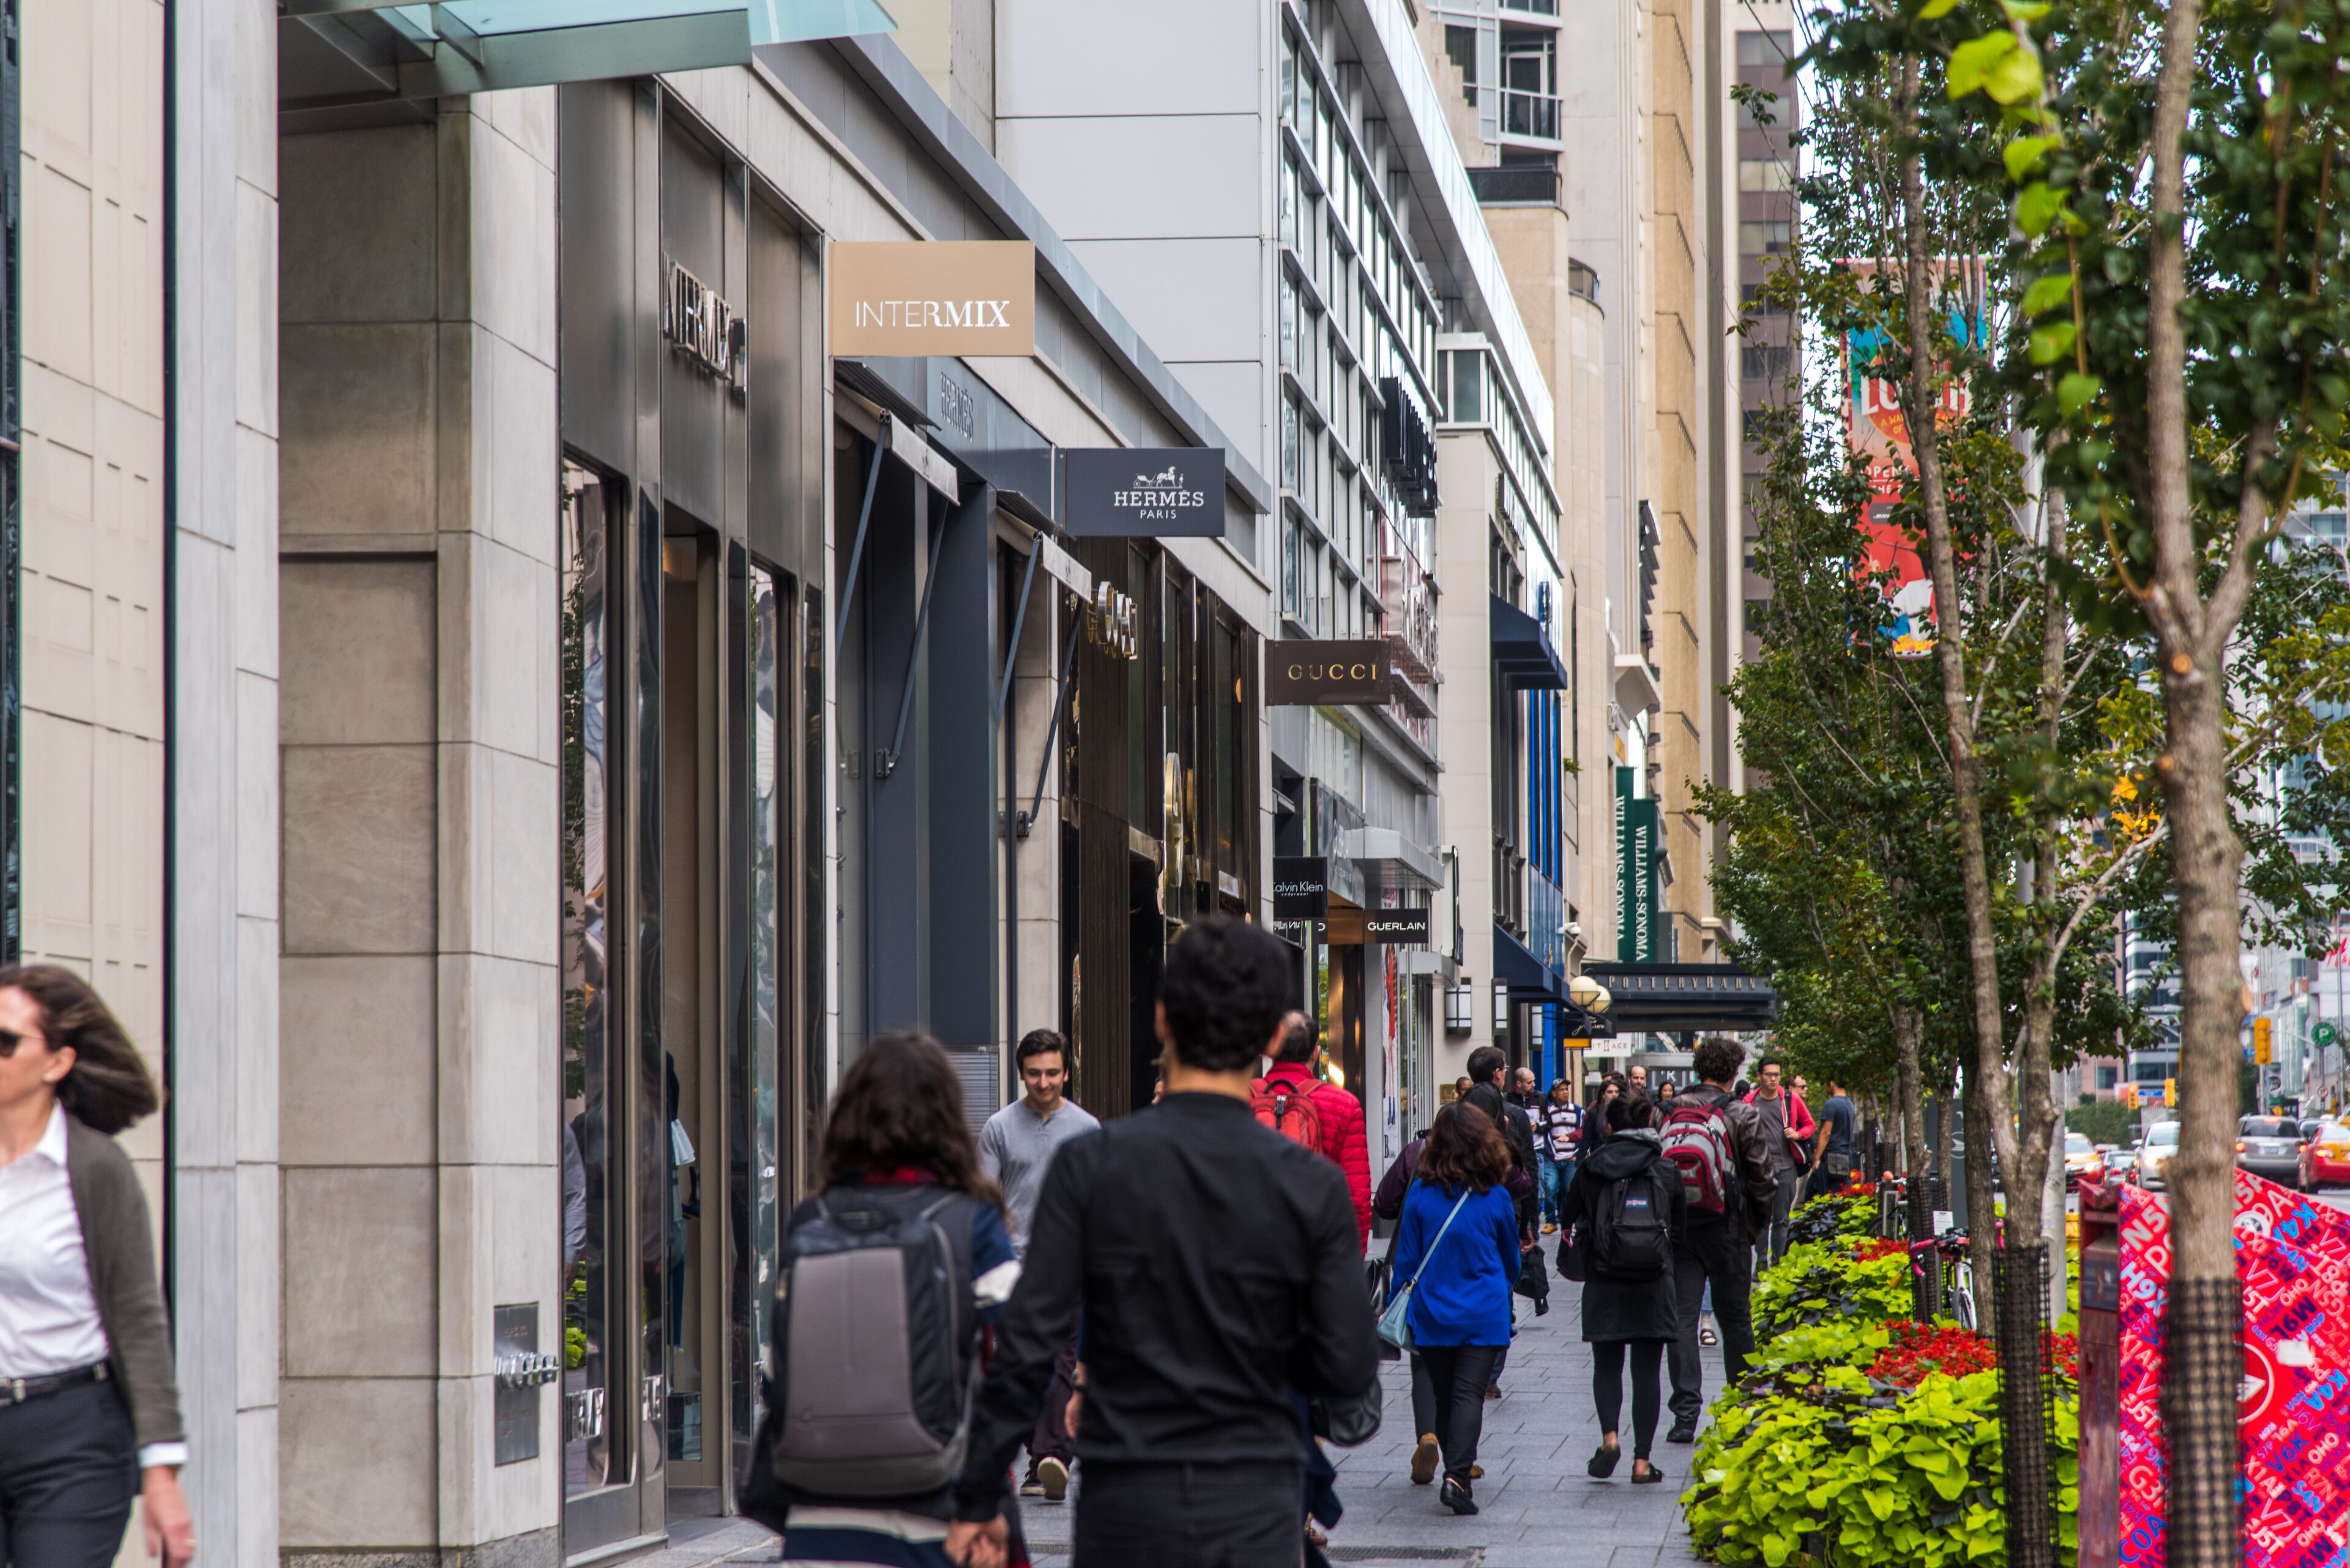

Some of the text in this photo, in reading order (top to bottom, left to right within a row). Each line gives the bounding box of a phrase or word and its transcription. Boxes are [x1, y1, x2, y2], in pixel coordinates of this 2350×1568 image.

[856, 300, 1010, 327] INTERMIX
[1140, 509, 1176, 520] PARIS
[1288, 663, 1376, 681] GUCCI
[1300, 881, 1323, 892] Klein
[1635, 825, 1648, 962] WILLIAMS-SONOMA
[1367, 922, 1425, 931] GUERLAIN
[2120, 1261, 2169, 1318] H9X
[2266, 1431, 2310, 1471] V6K
